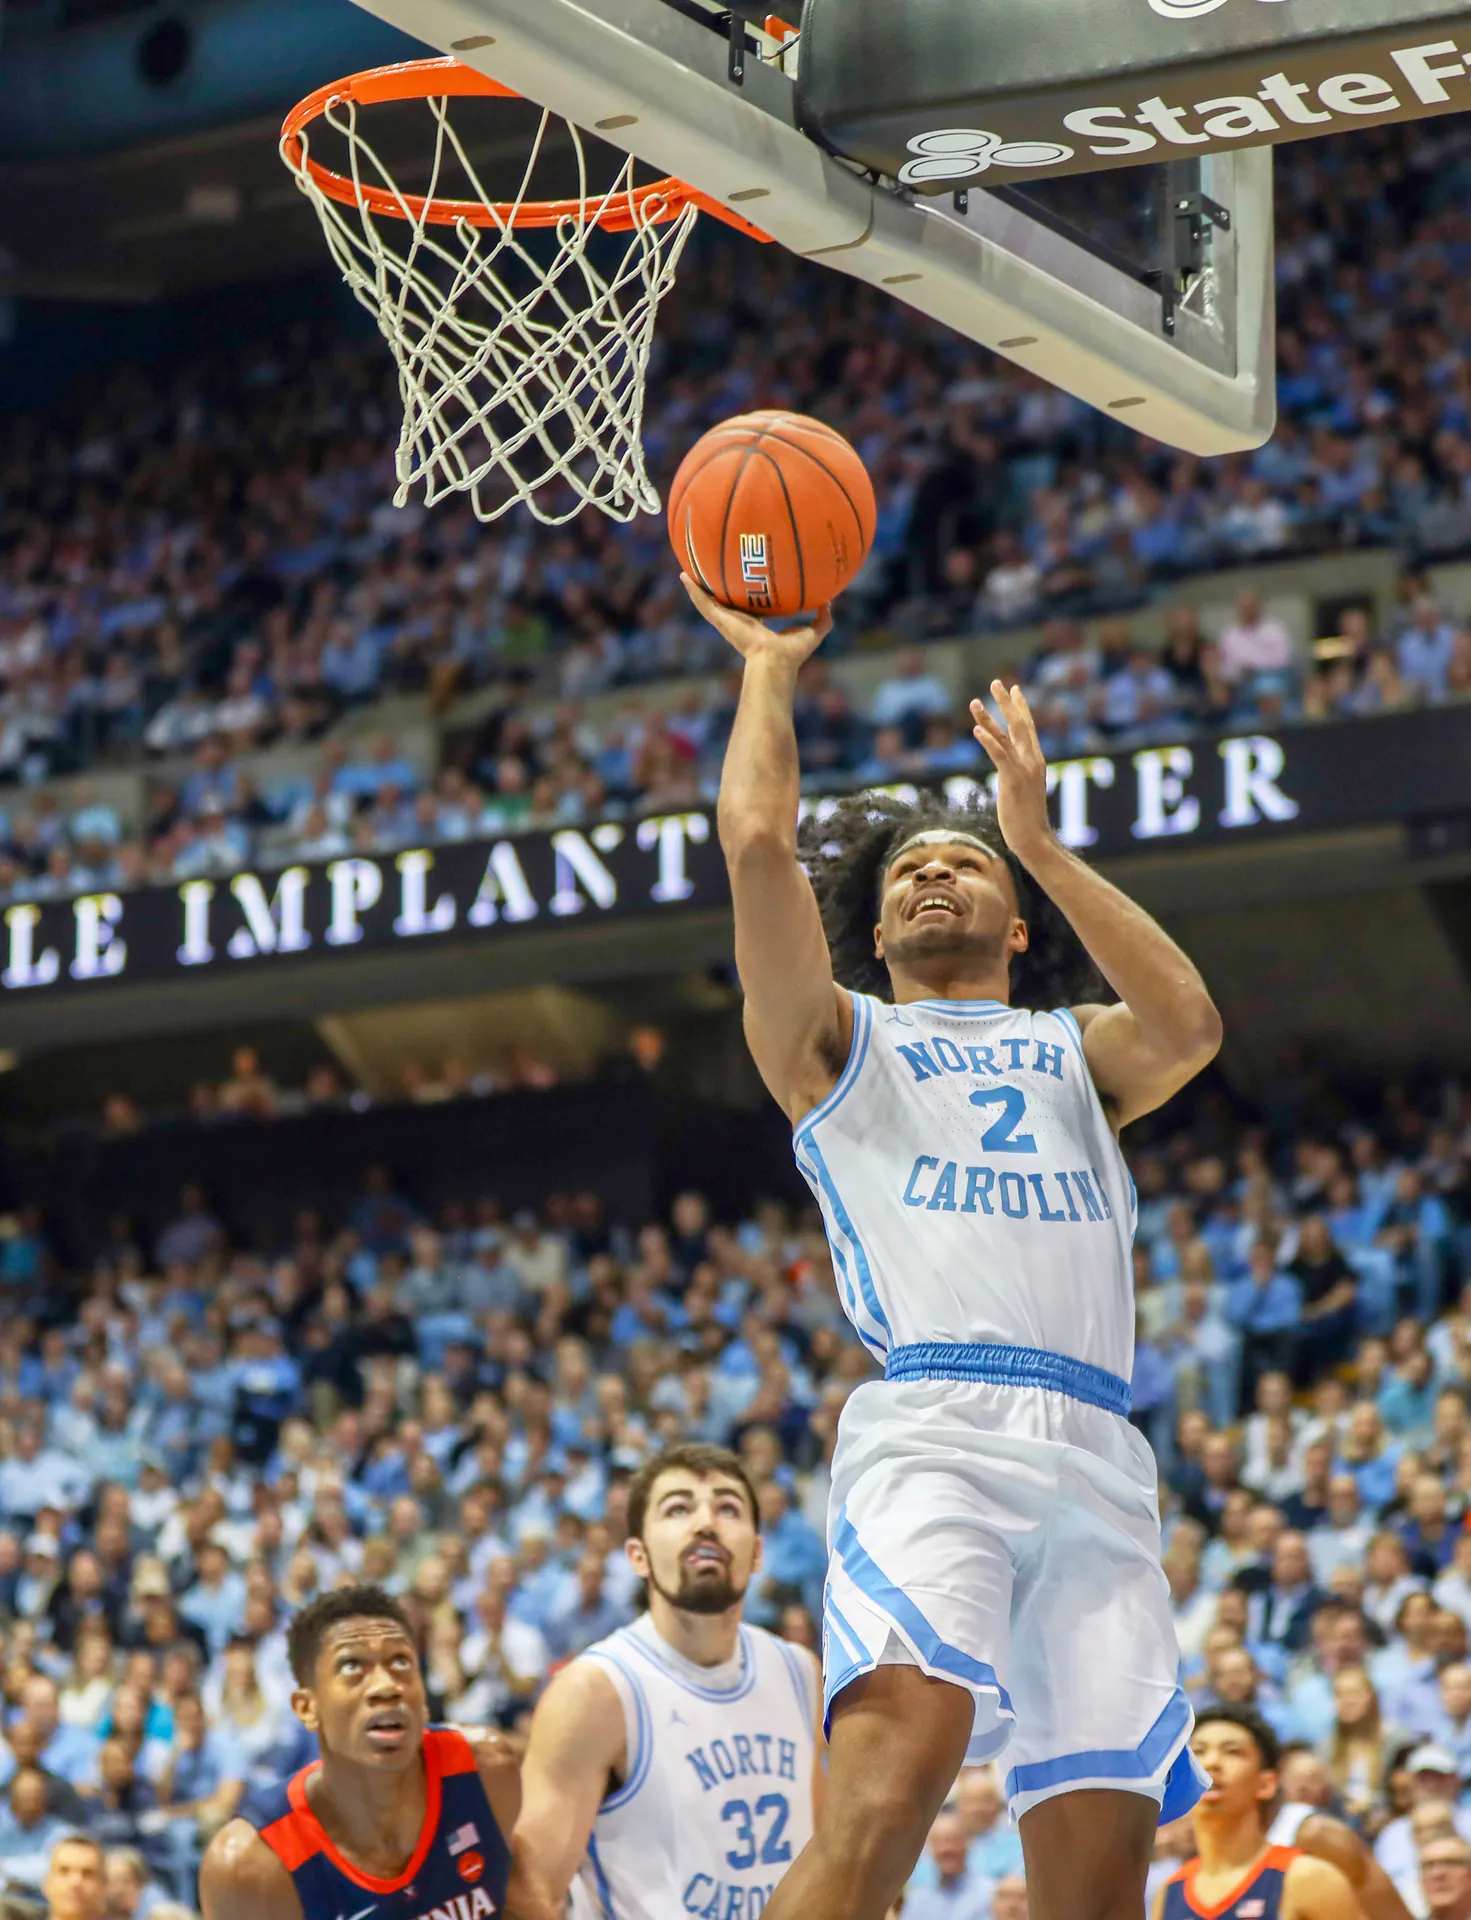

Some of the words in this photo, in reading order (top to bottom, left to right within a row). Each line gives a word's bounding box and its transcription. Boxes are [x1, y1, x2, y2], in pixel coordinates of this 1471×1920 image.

[1063, 40, 1471, 155] StateF
[176, 812, 710, 966] IMPLANT
[896, 1036, 1066, 1083] NORTH
[968, 1085, 1039, 1154] 2
[685, 1733, 798, 1792] NORTH
[720, 1793, 792, 1870] 32
